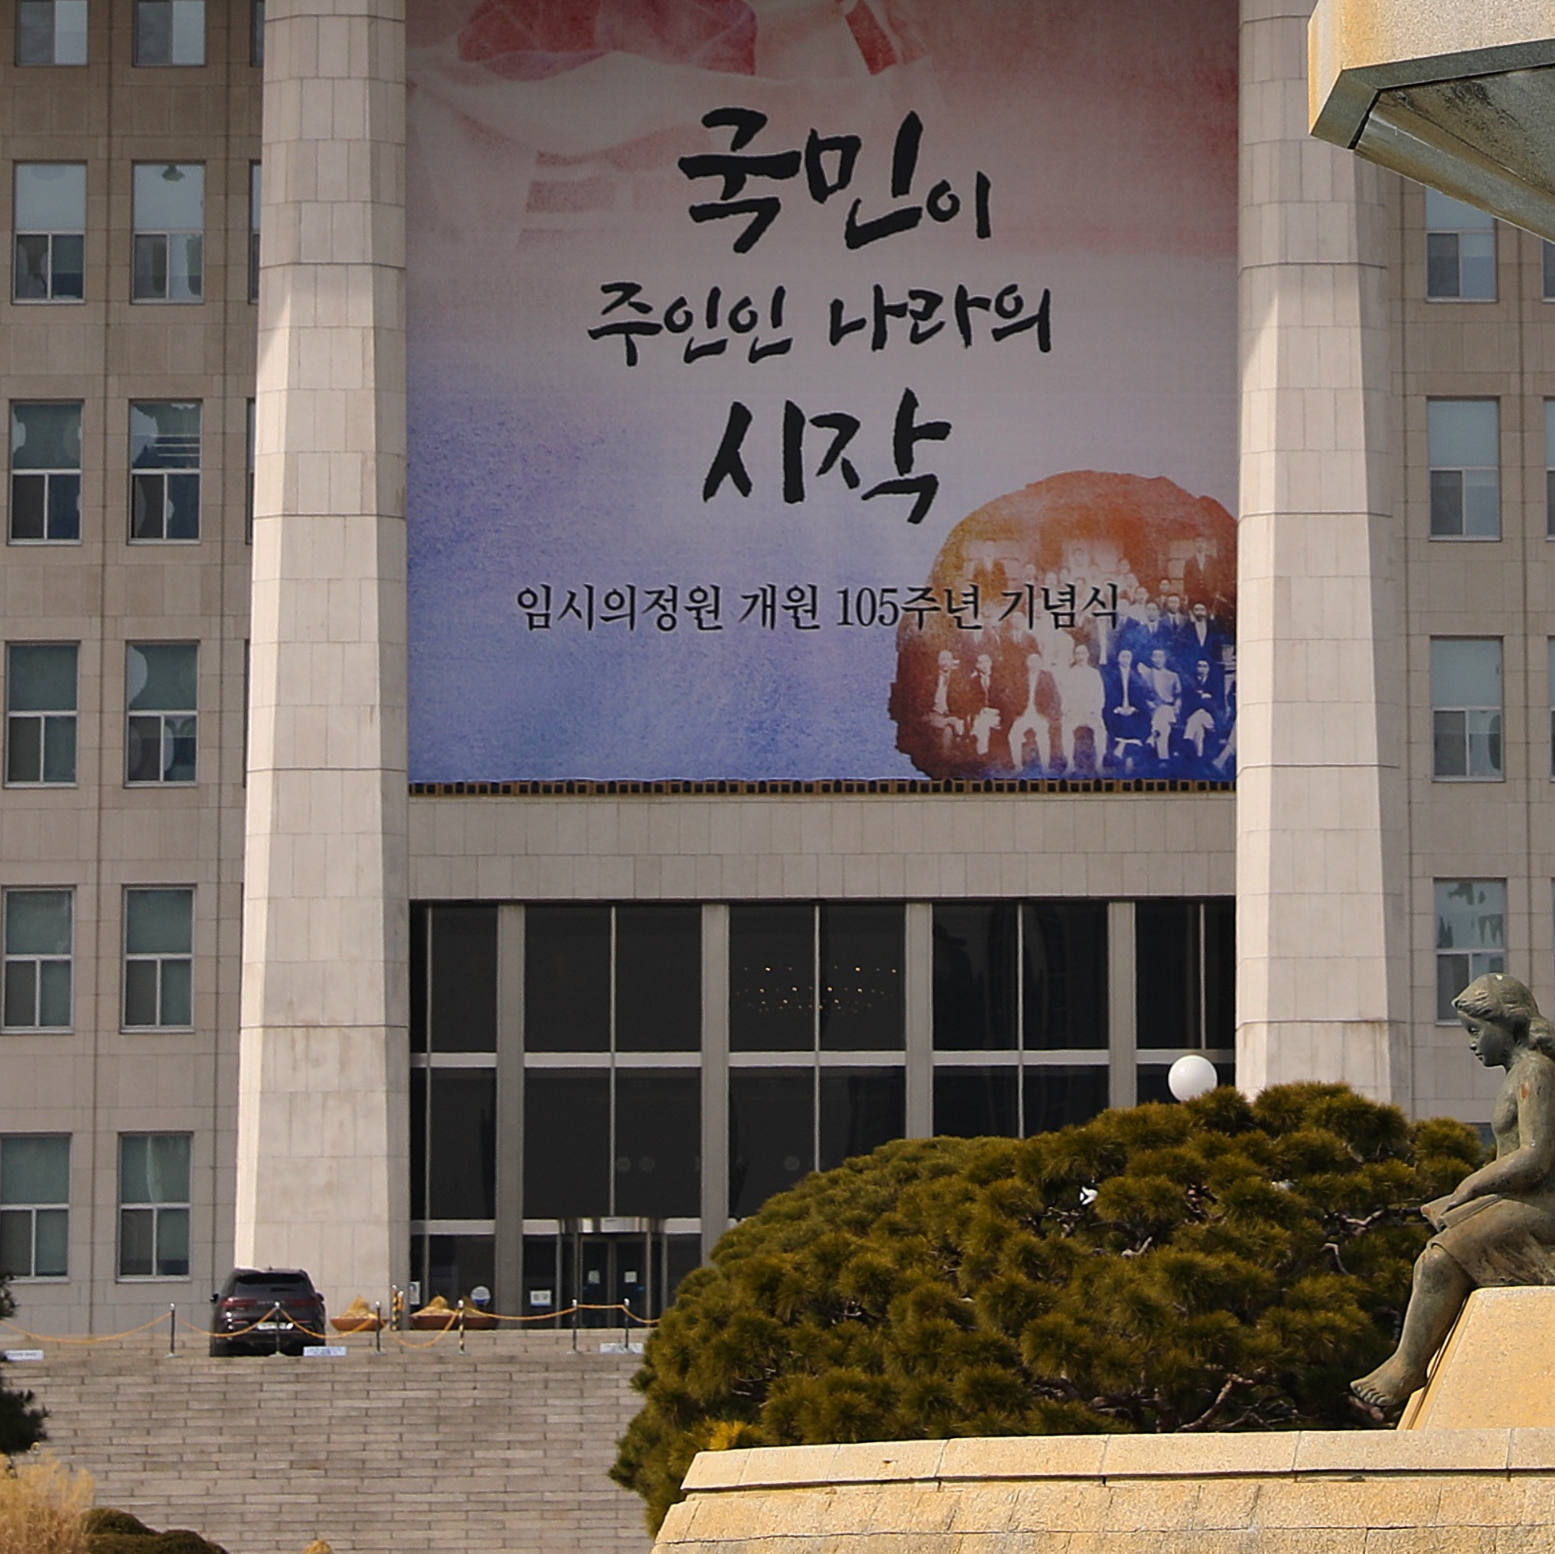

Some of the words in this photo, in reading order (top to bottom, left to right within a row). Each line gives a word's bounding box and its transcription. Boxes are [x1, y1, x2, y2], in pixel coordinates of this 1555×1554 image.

[678, 107, 992, 254] 국민이
[588, 282, 793, 367] 주인인
[830, 284, 1052, 353] 나라의
[703, 388, 952, 525] 시작
[516, 583, 724, 632] 임시의정원
[738, 583, 821, 632] 개원
[836, 584, 983, 632] 105주년
[999, 582, 1121, 632] 기념식
